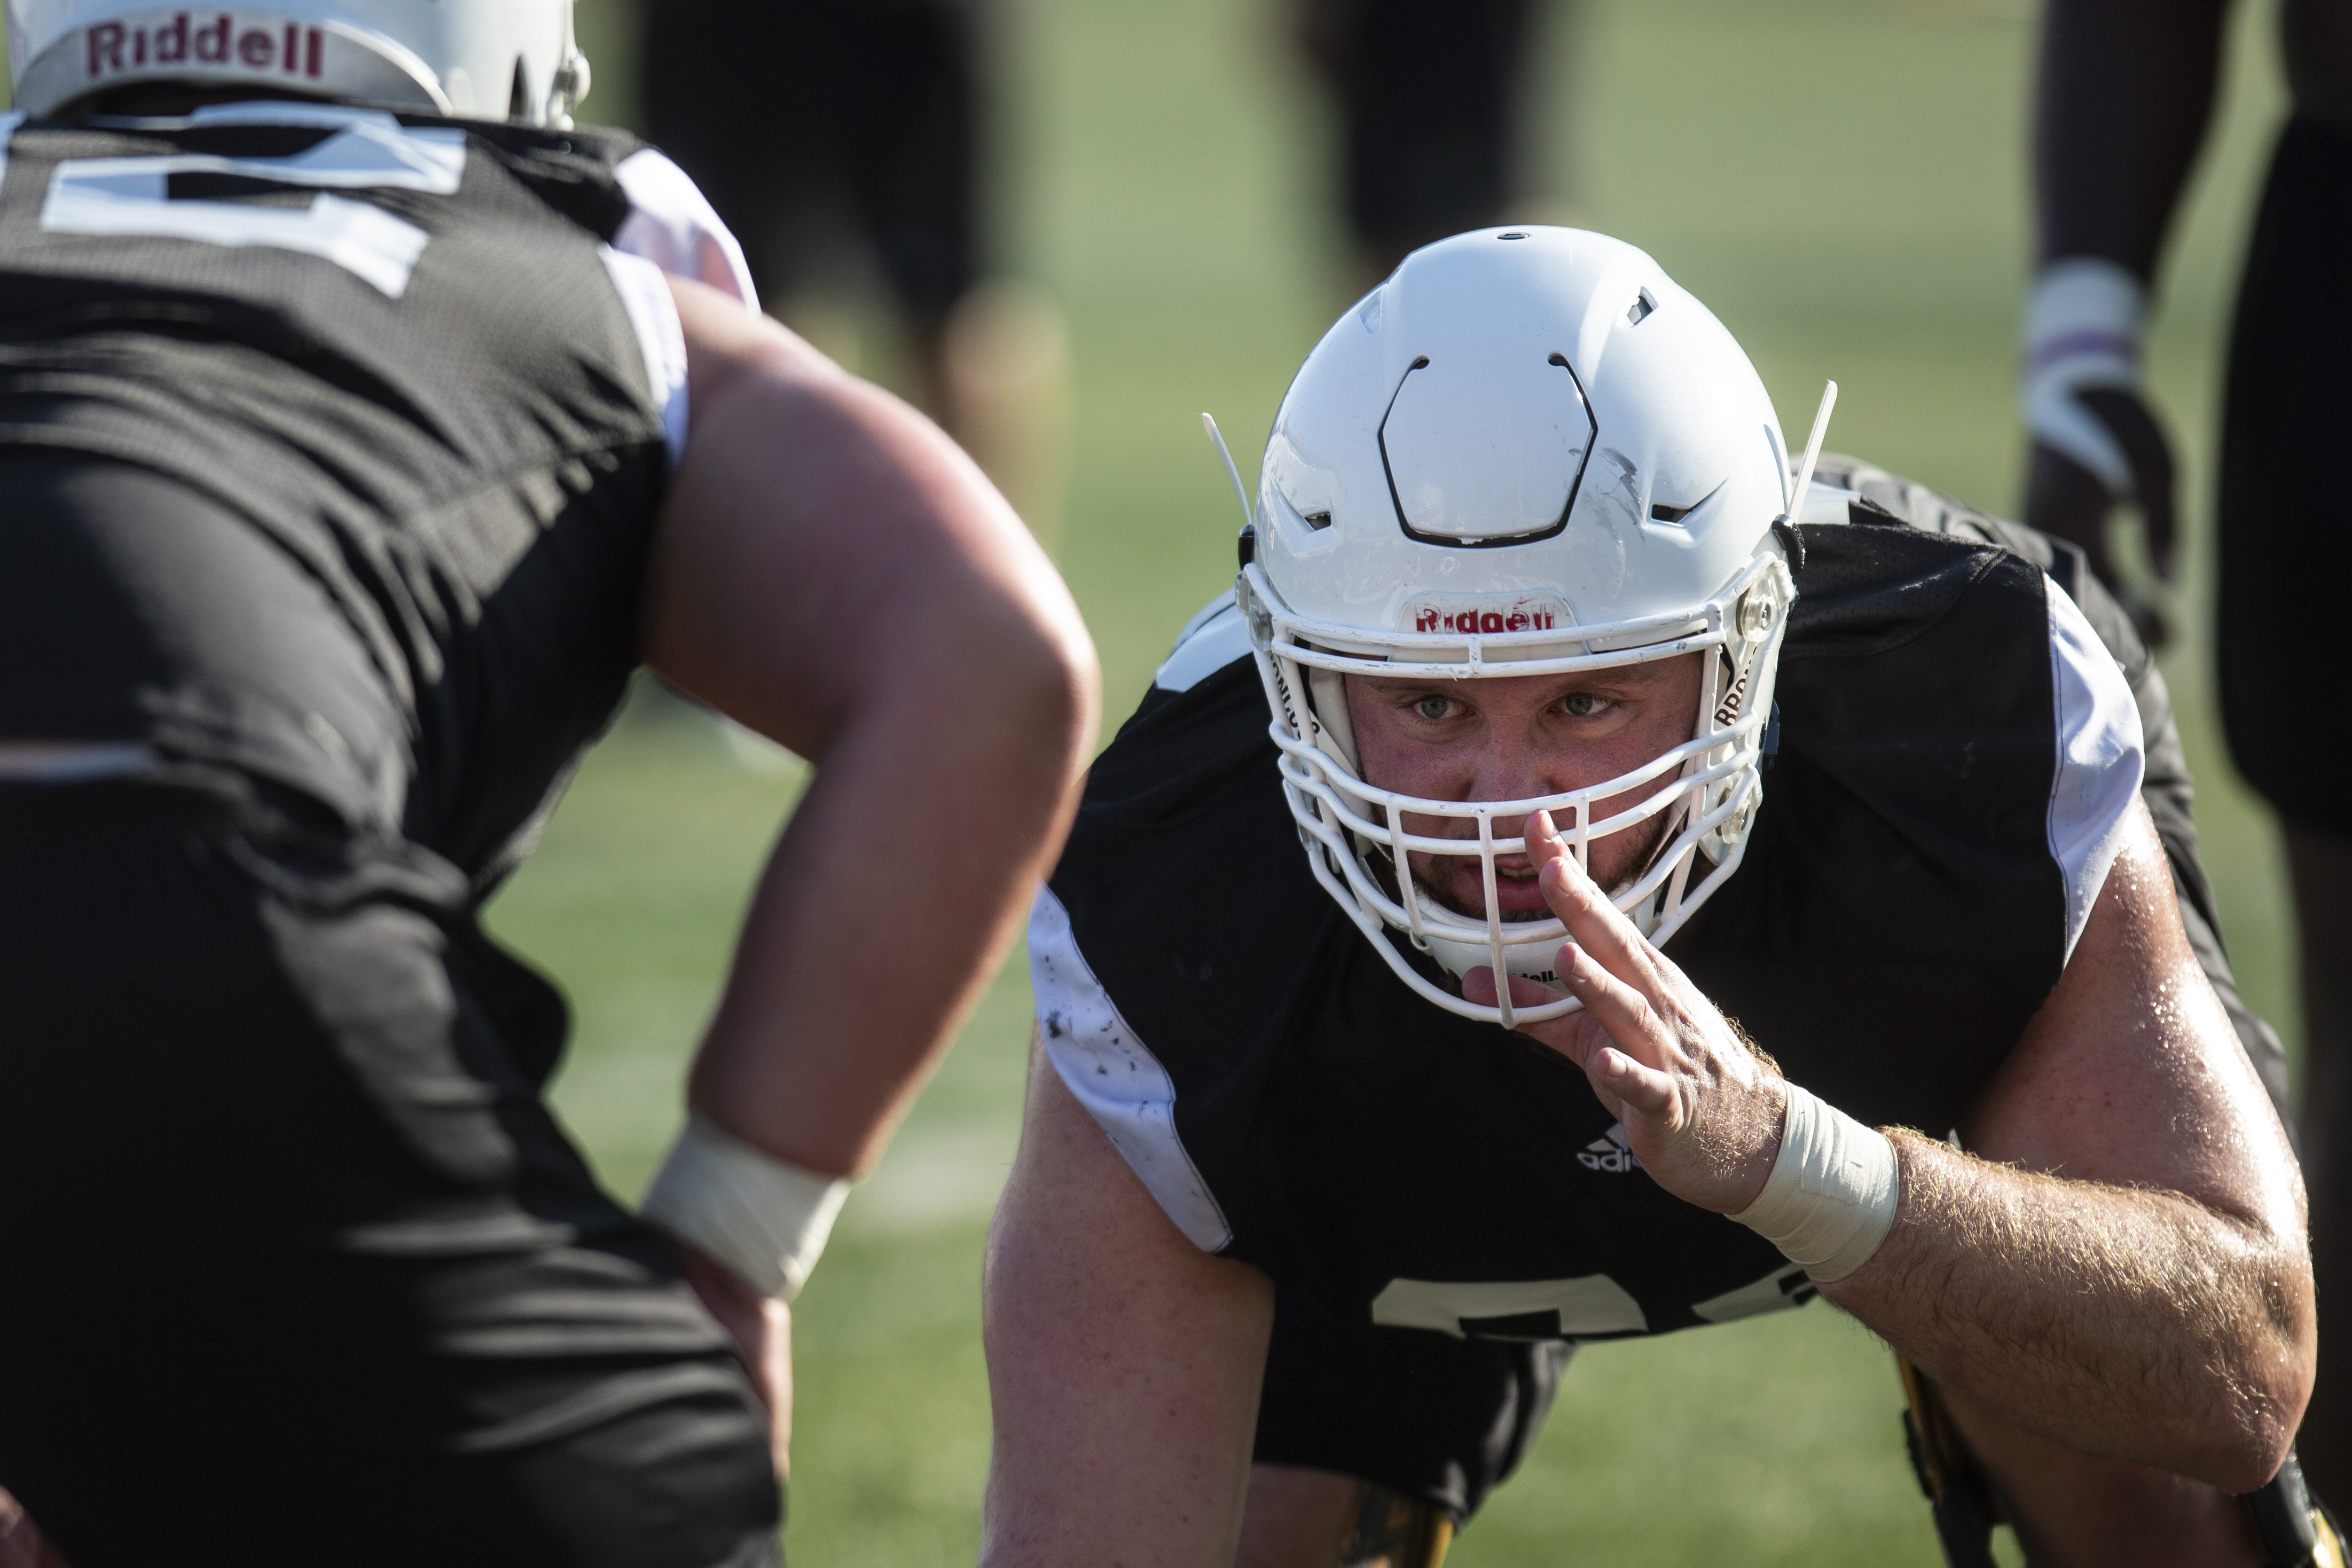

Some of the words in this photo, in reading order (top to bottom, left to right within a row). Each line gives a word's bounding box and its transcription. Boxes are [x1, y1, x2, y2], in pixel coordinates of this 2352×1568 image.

[87, 11, 324, 79] Riddell
[1415, 603, 1555, 634] Riddell
[1577, 1148, 1643, 1173] adi
